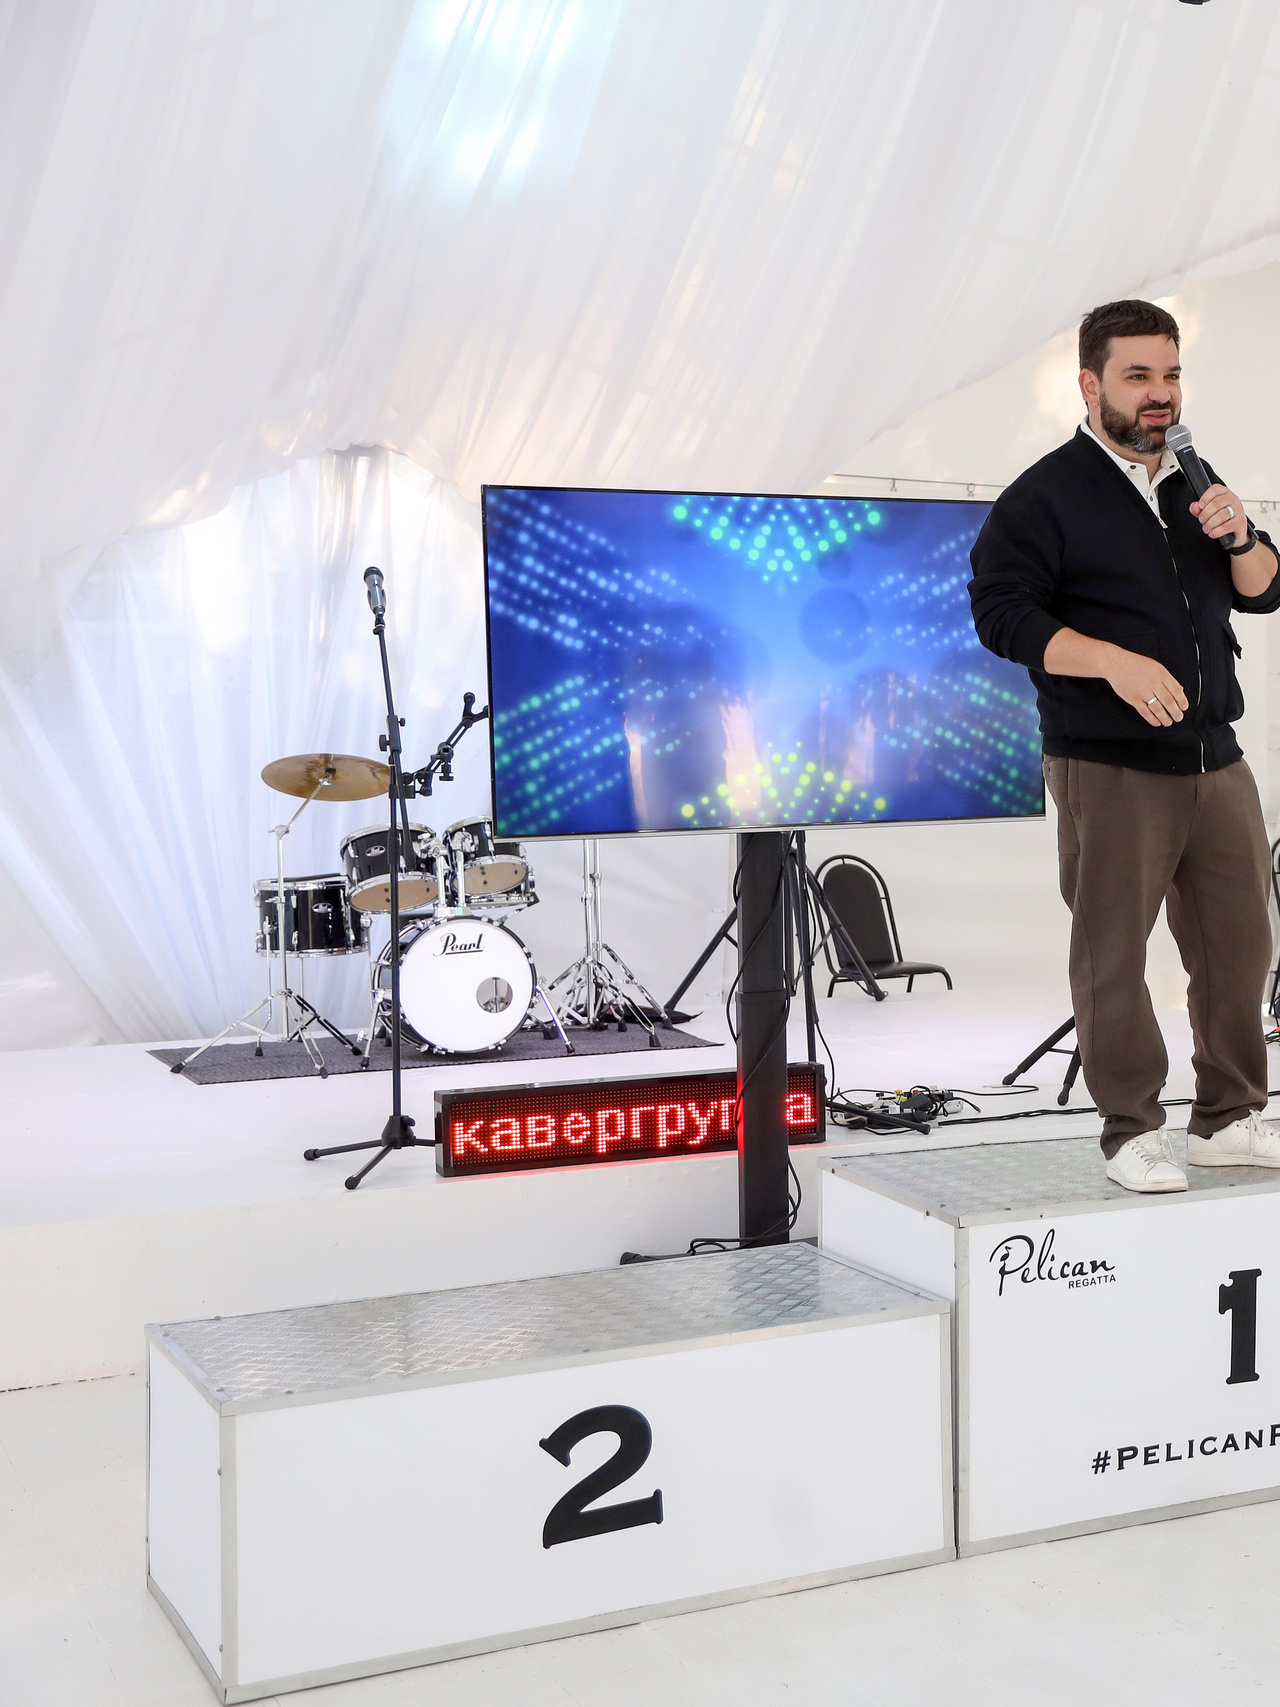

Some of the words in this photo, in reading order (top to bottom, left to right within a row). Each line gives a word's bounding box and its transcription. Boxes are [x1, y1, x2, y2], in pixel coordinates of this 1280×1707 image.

[433, 933, 483, 956] Pearl
[989, 1228, 1115, 1296] Pelican
[1068, 1274, 1116, 1289] REGATTA
[1219, 1268, 1262, 1385] 1
[539, 1405, 663, 1549] 2
